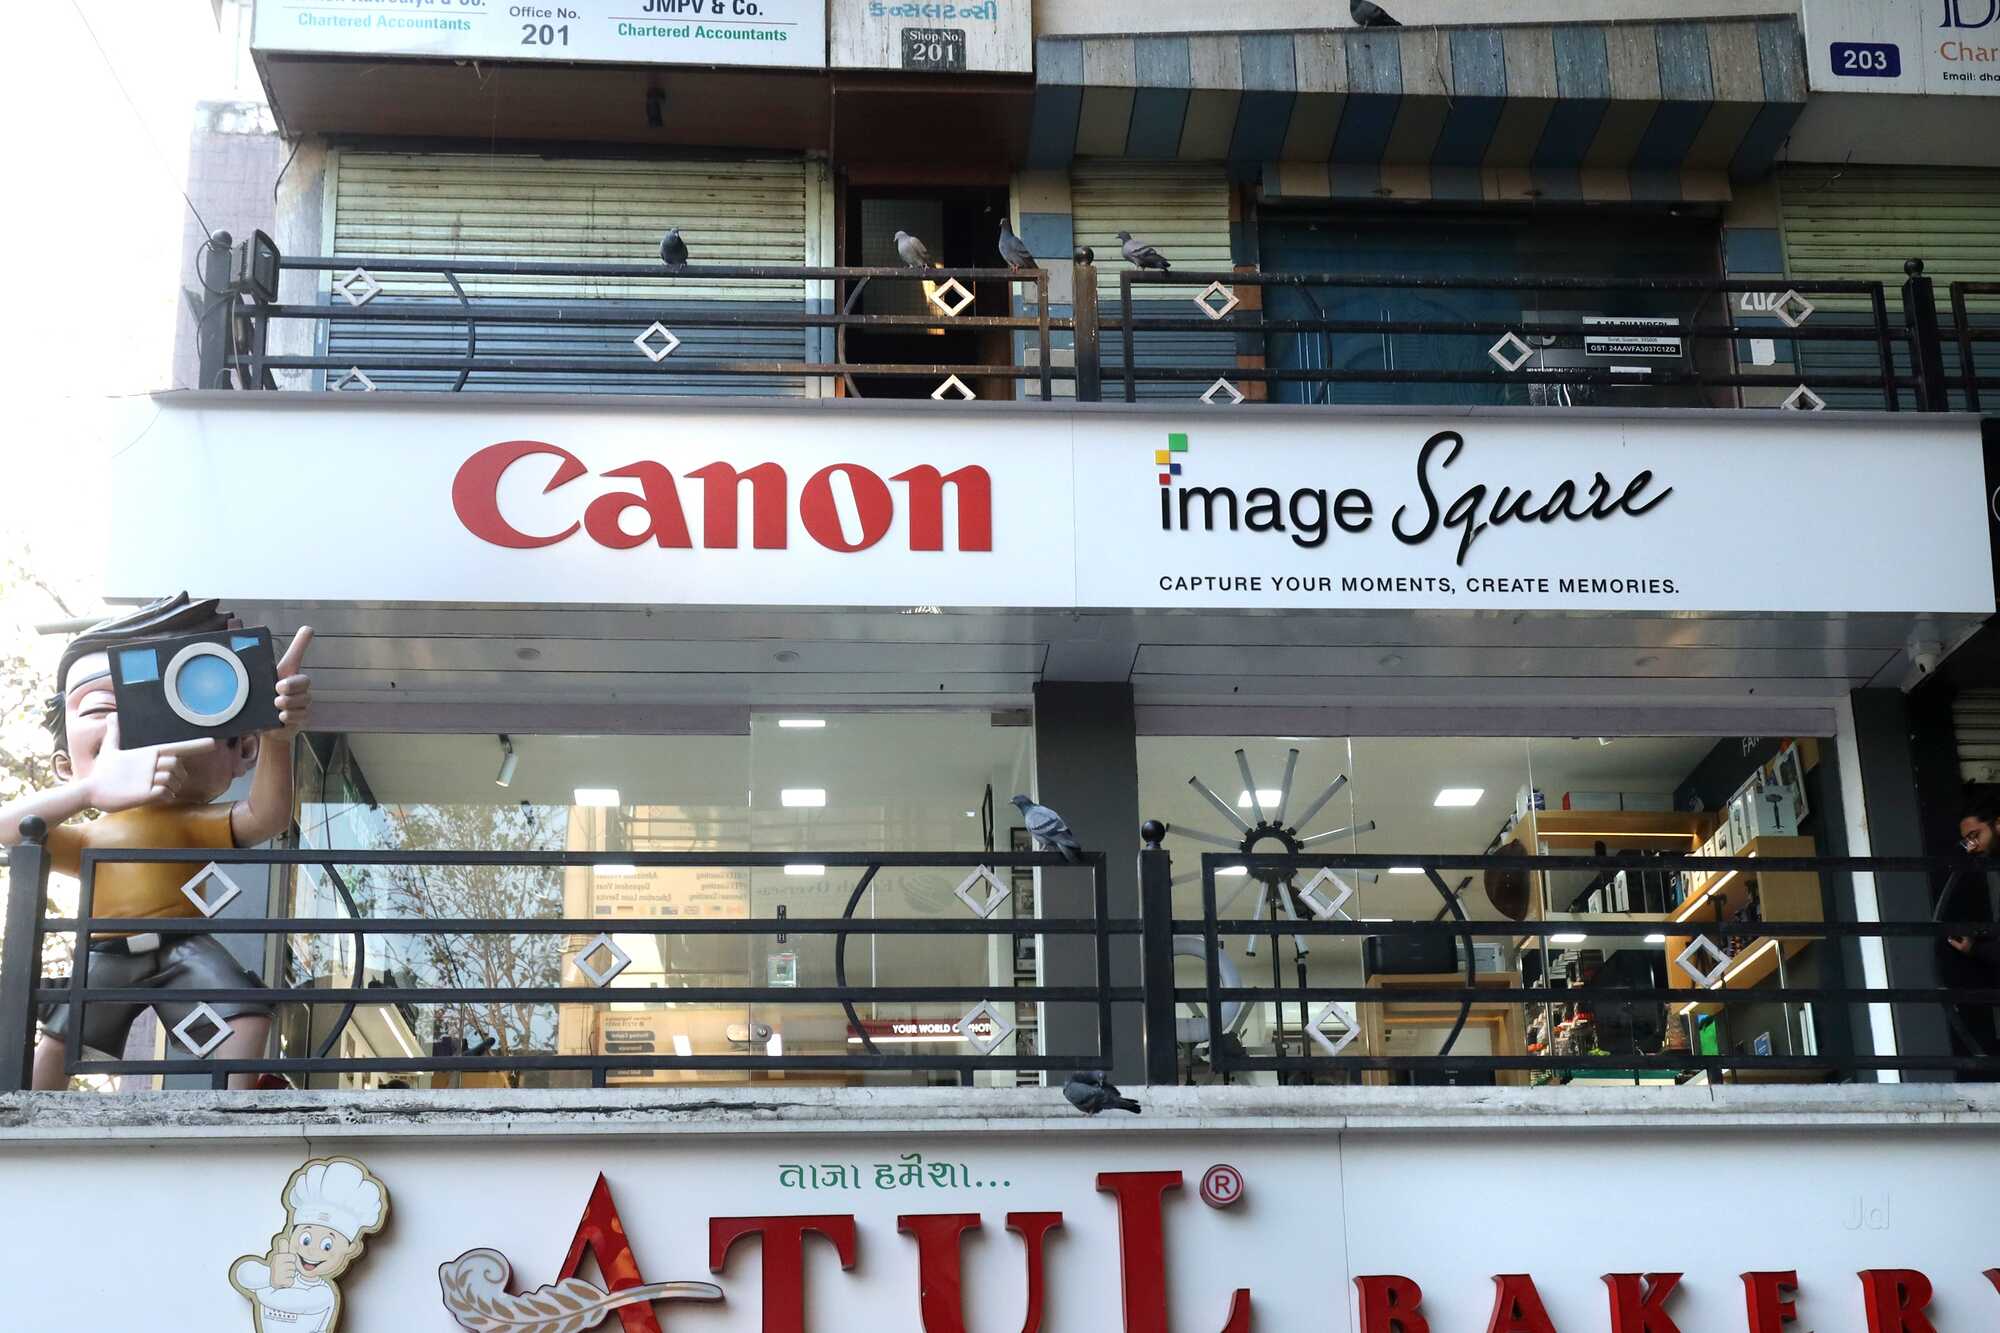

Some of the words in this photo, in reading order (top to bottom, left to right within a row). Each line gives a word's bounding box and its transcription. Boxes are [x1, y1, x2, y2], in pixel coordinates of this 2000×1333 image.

[509, 6, 552, 19] Office
[557, 7, 581, 20] No.
[733, 0, 763, 16] Co.
[298, 12, 371, 28] Chartered
[376, 14, 471, 31] Accountants
[521, 23, 569, 46] 201
[618, 22, 690, 39] Chartered
[695, 24, 787, 42] Accountants
[909, 31, 940, 43] Shop
[942, 31, 962, 42] No.
[912, 43, 954, 62] 201
[1843, 49, 1888, 70] 203
[1943, 71, 1976, 81] Email:
[452, 440, 992, 553] Canon
[1158, 470, 1374, 549] image
[1392, 430, 1673, 567] Square
[1159, 575, 1262, 591] CAPTURE
[1272, 576, 1332, 591] YOUR
[1342, 577, 1456, 594] MOMENTS,
[1466, 577, 1550, 593] CREATE
[1559, 578, 1680, 594] MEMORIES.
[892, 1023, 917, 1034] YOUR
[919, 1023, 951, 1034] WORLD
[778, 1163, 861, 1189] તાજા
[556, 1171, 1250, 1333] ATUL
[1352, 1267, 2000, 1333] BAKER
